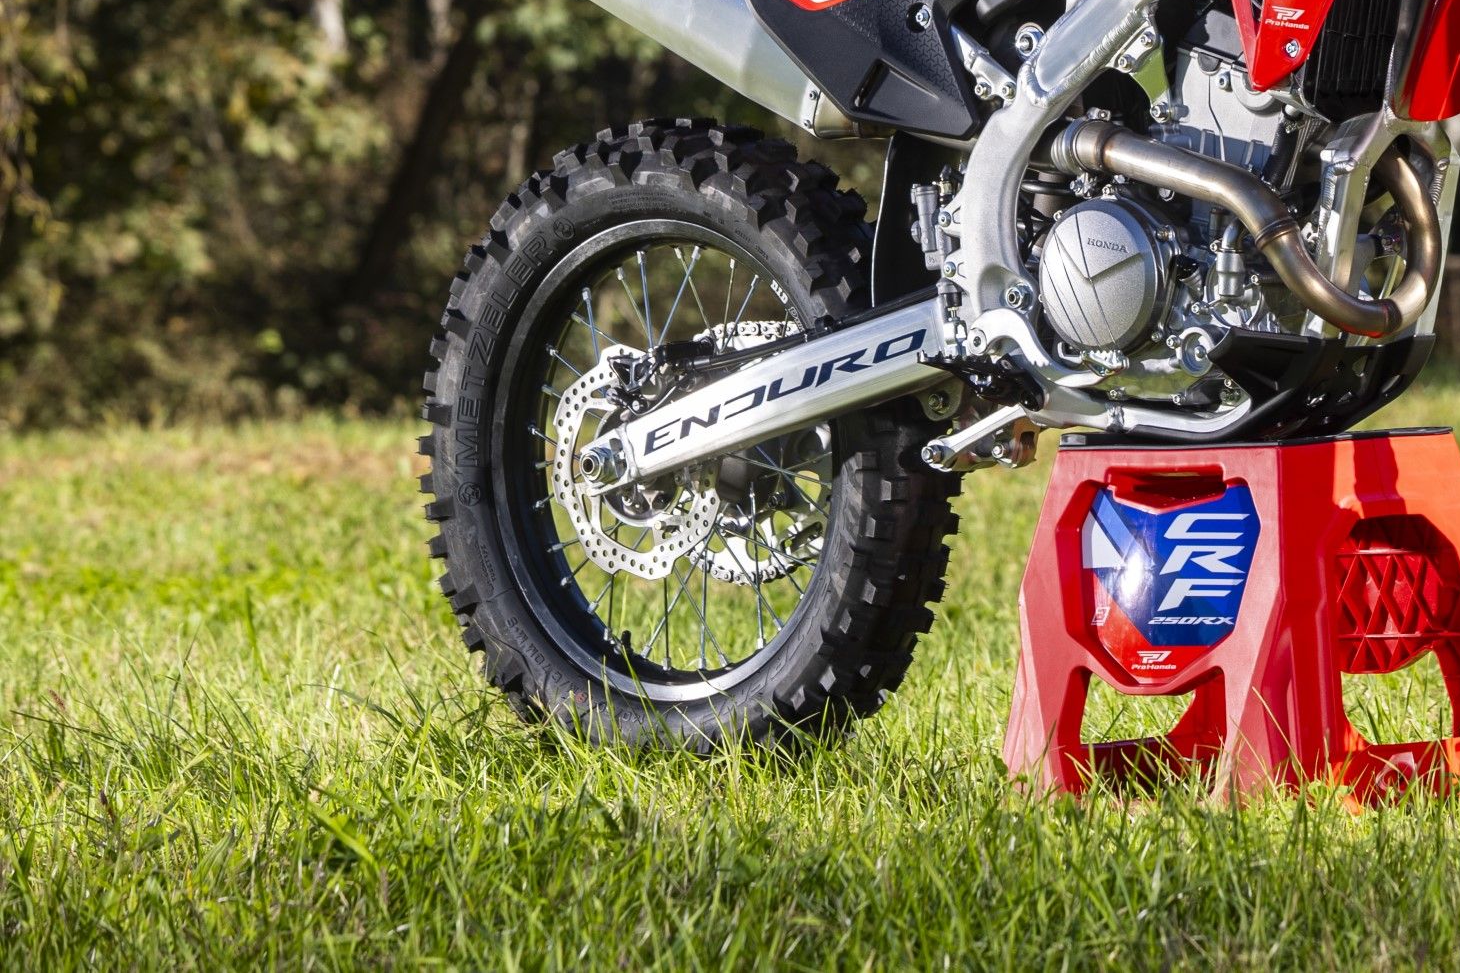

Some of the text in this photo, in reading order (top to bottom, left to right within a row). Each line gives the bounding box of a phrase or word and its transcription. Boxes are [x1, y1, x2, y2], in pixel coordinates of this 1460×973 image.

[1086, 237, 1130, 254] HONDA
[454, 232, 549, 467] METZELER
[643, 328, 927, 457] ENDURO
[1157, 513, 1251, 612] CRF
[1148, 616, 1235, 625] 250RX
